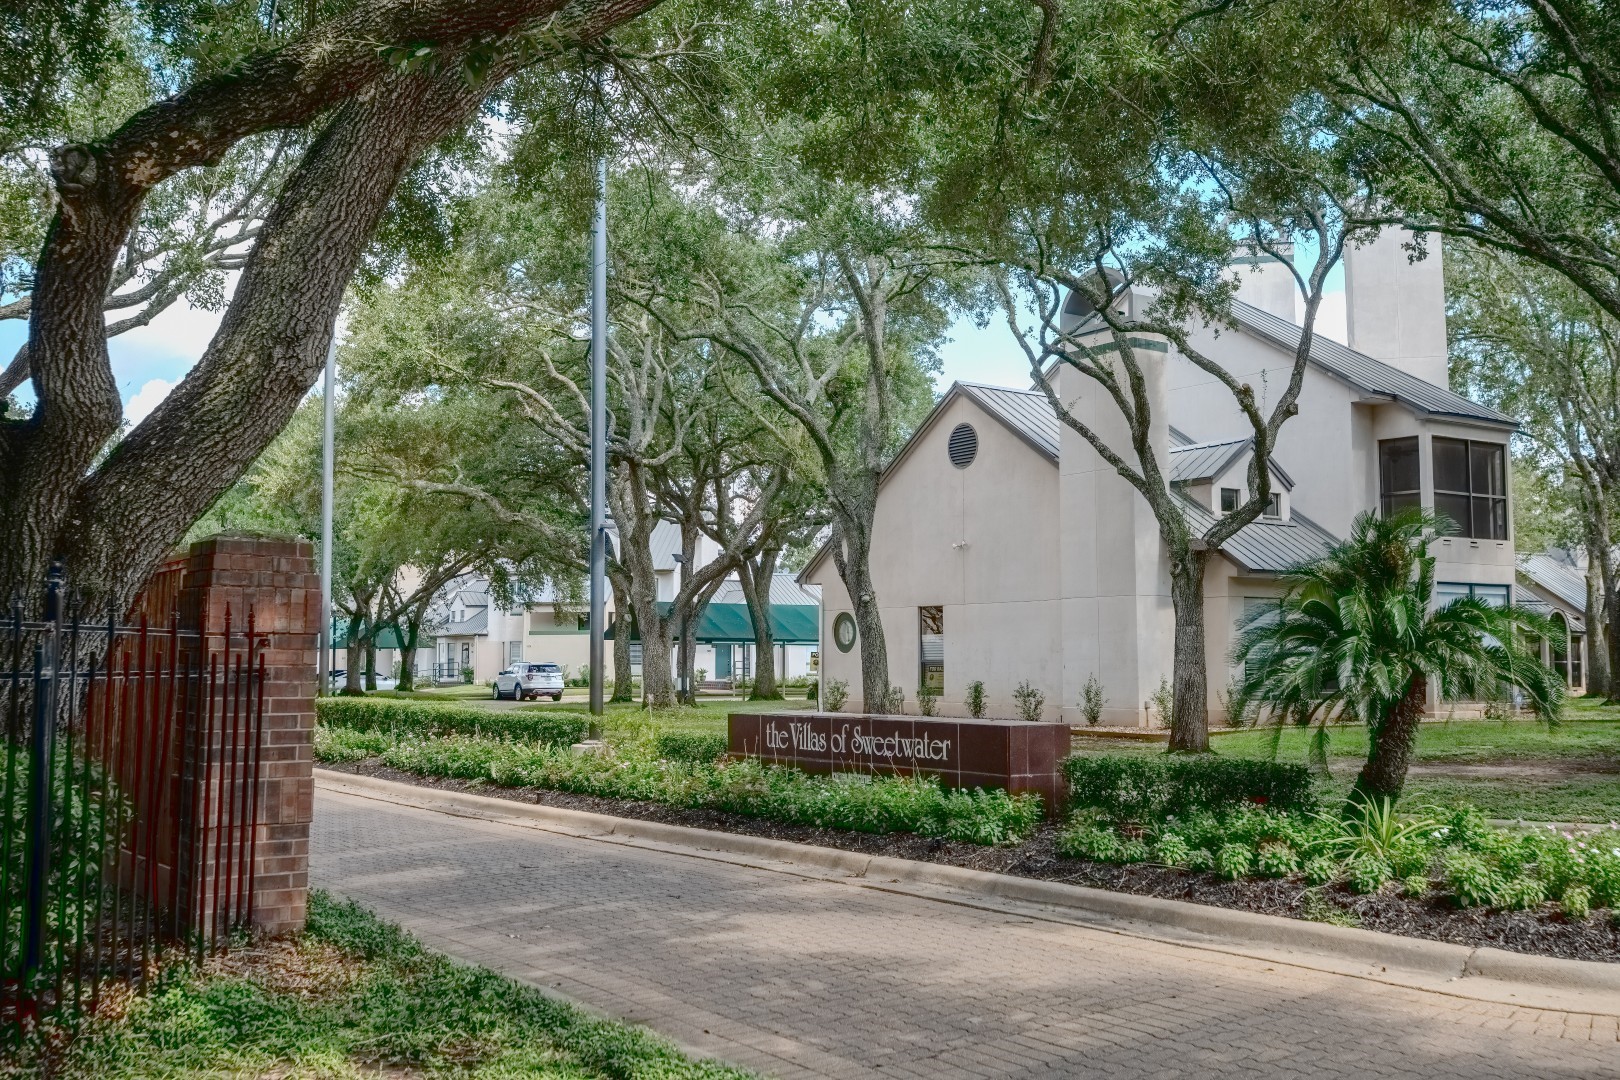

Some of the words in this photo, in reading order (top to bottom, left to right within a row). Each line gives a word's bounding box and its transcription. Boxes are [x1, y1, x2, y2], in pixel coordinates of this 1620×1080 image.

[766, 720, 789, 749] the
[789, 721, 827, 752] Villas
[830, 723, 850, 753] of
[851, 725, 951, 760] Sweetwater
